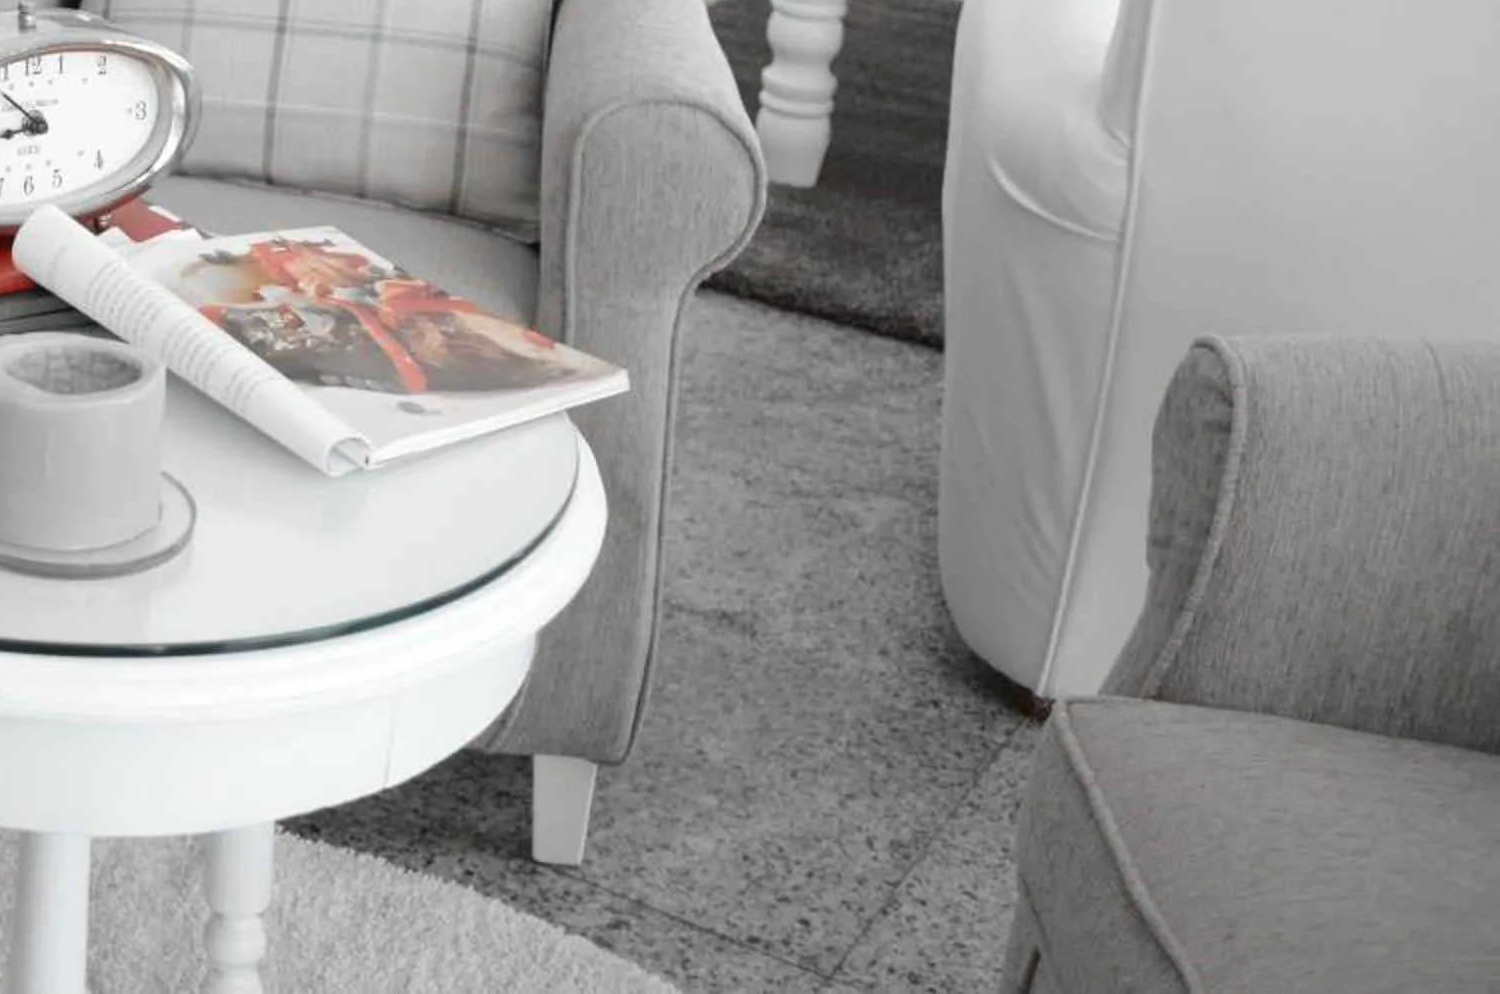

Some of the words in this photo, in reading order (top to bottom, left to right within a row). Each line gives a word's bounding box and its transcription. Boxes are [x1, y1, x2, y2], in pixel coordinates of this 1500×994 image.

[25, 55, 42, 76] 12
[57, 55, 65, 74] 1
[97, 56, 108, 75] 2
[135, 101, 148, 121] 3
[93, 149, 104, 170] 4
[23, 175, 35, 196] 6
[52, 168, 63, 188] 5
